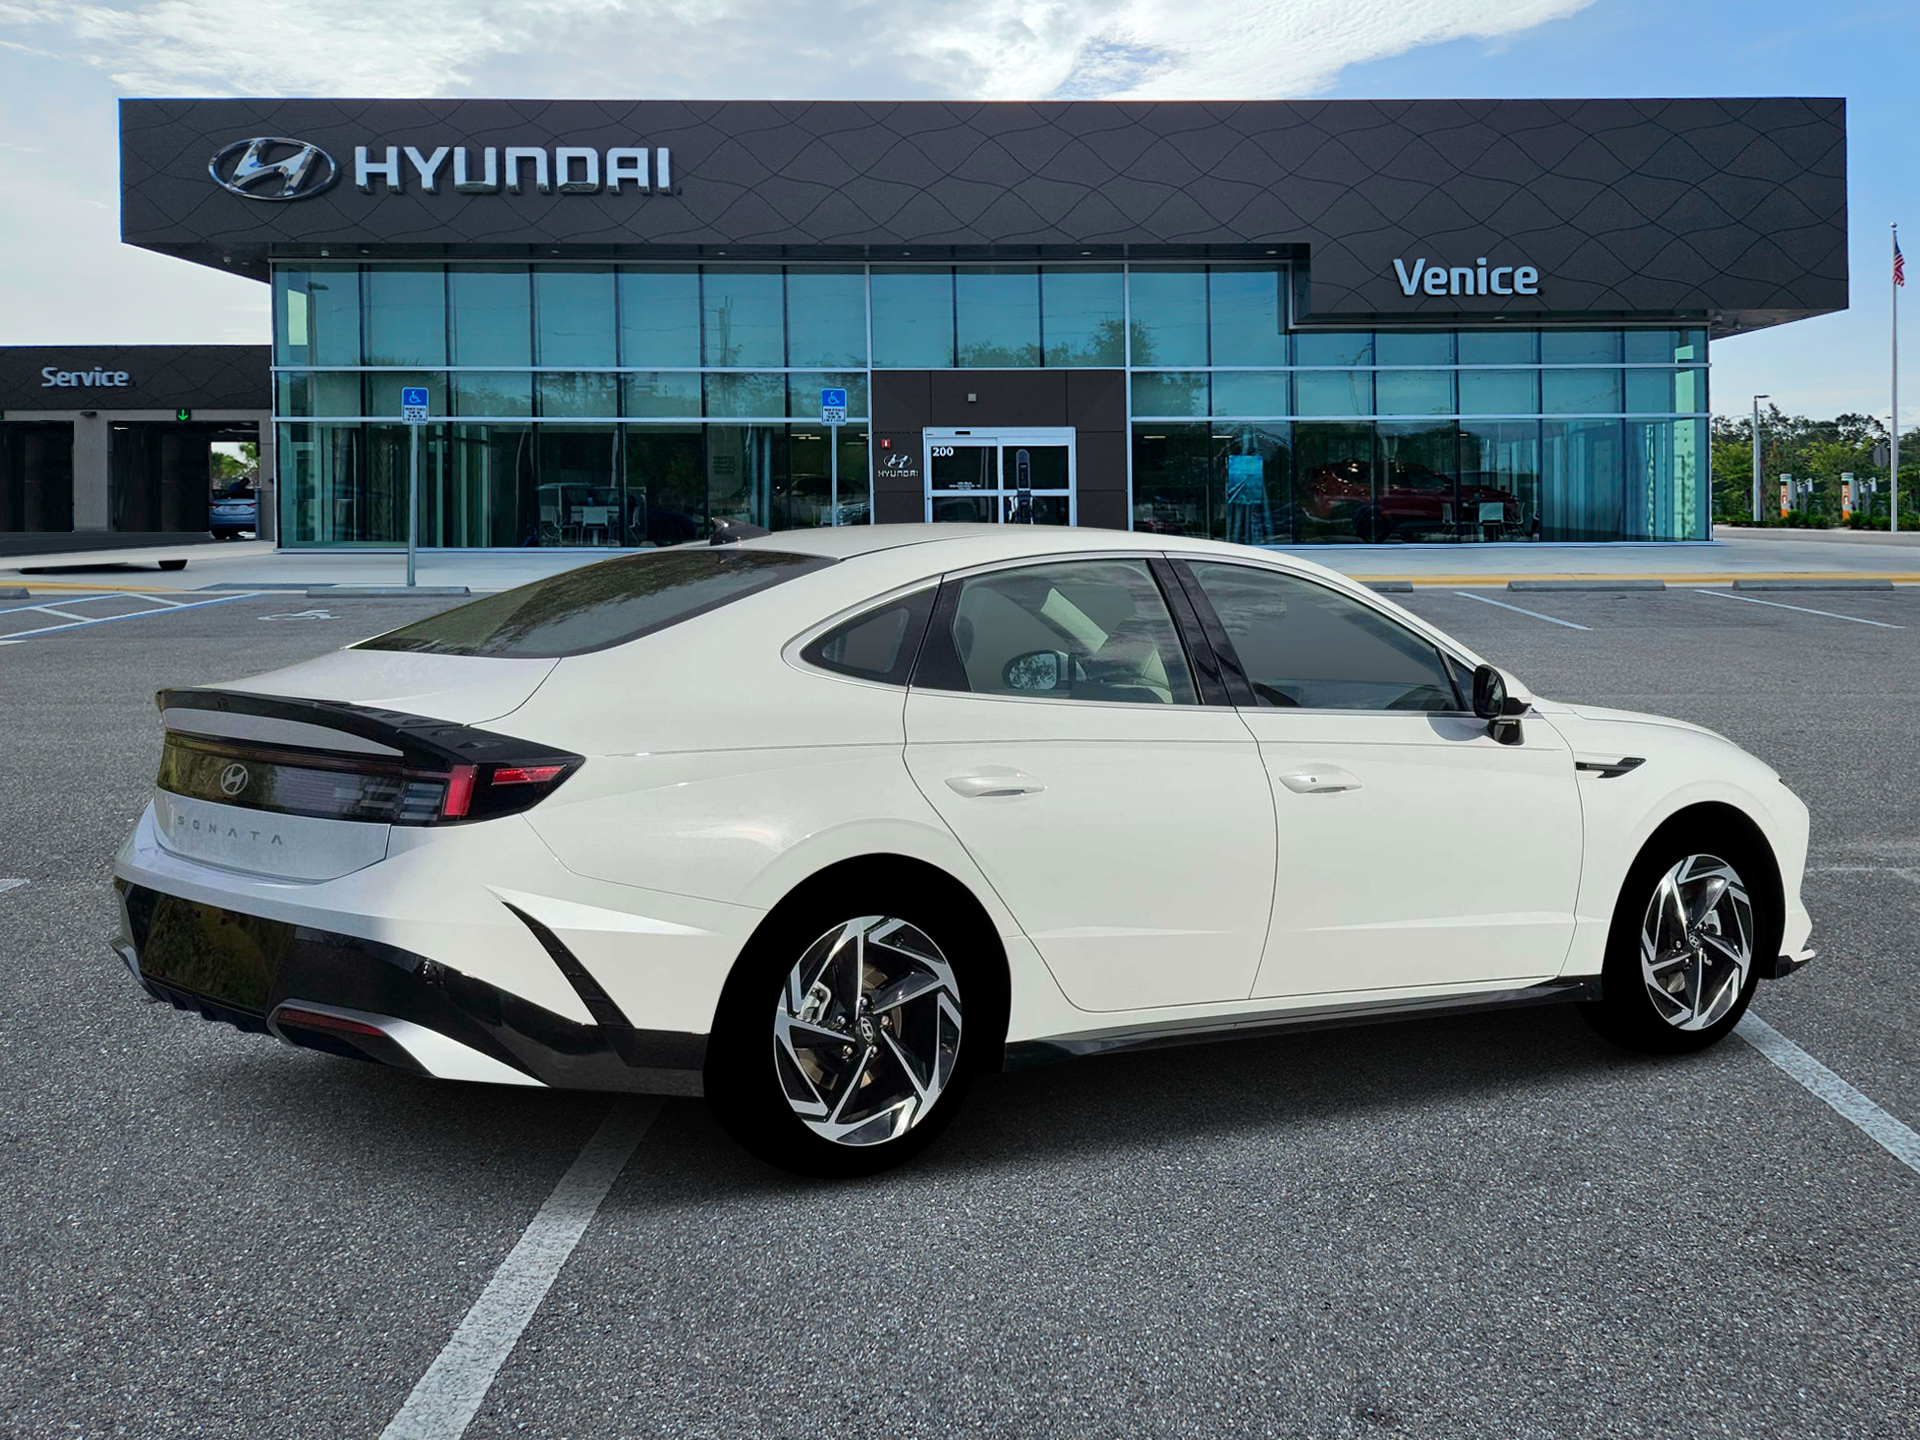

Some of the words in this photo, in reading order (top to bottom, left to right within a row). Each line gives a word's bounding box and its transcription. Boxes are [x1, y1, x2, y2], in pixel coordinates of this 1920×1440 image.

[354, 146, 672, 195] HYUNDAI
[1392, 257, 1539, 296] Venice
[41, 366, 130, 387] Service
[932, 446, 954, 457] 200
[877, 469, 919, 478] HYUNDAI
[177, 815, 283, 845] SONATA
